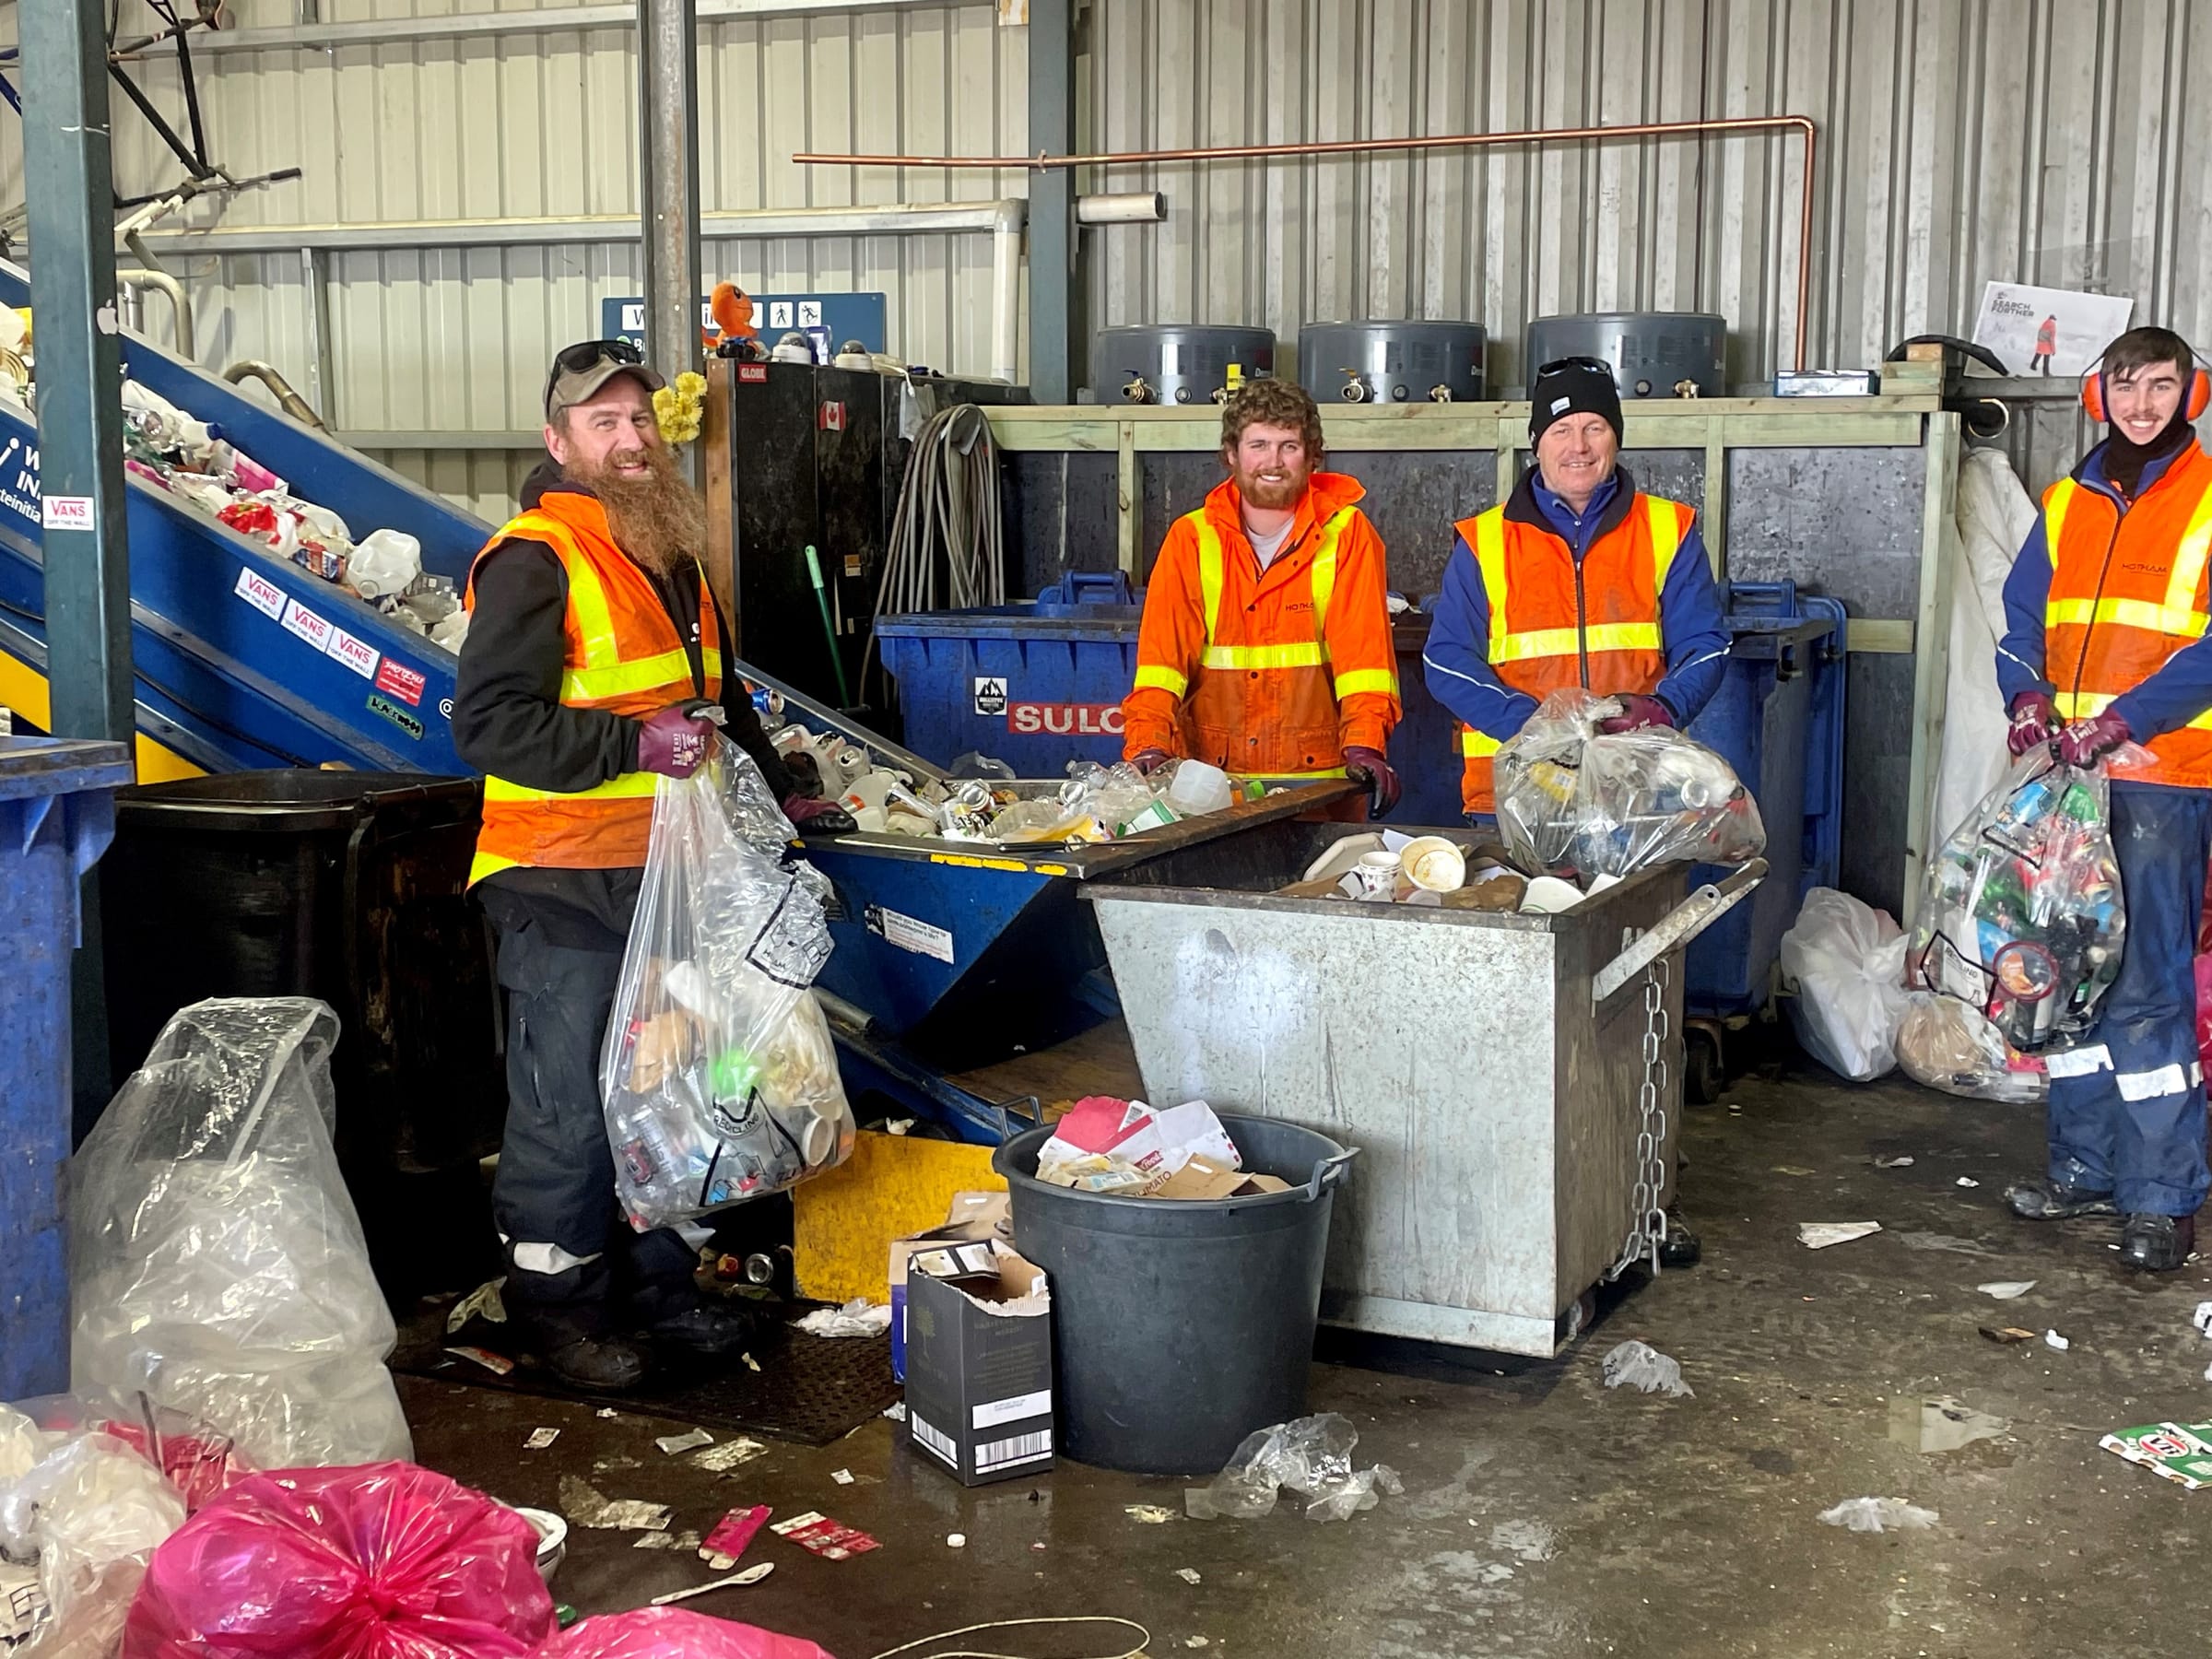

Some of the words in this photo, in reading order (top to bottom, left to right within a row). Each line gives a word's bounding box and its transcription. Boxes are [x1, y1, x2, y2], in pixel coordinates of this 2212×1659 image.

[1991, 306, 2035, 317] FURTHER
[1993, 300, 2031, 311] SEARCH
[740, 367, 766, 379] GLOBE
[51, 500, 86, 517] VANS
[247, 573, 280, 606] VANS
[294, 606, 327, 638] VANS
[340, 633, 373, 665] VANS
